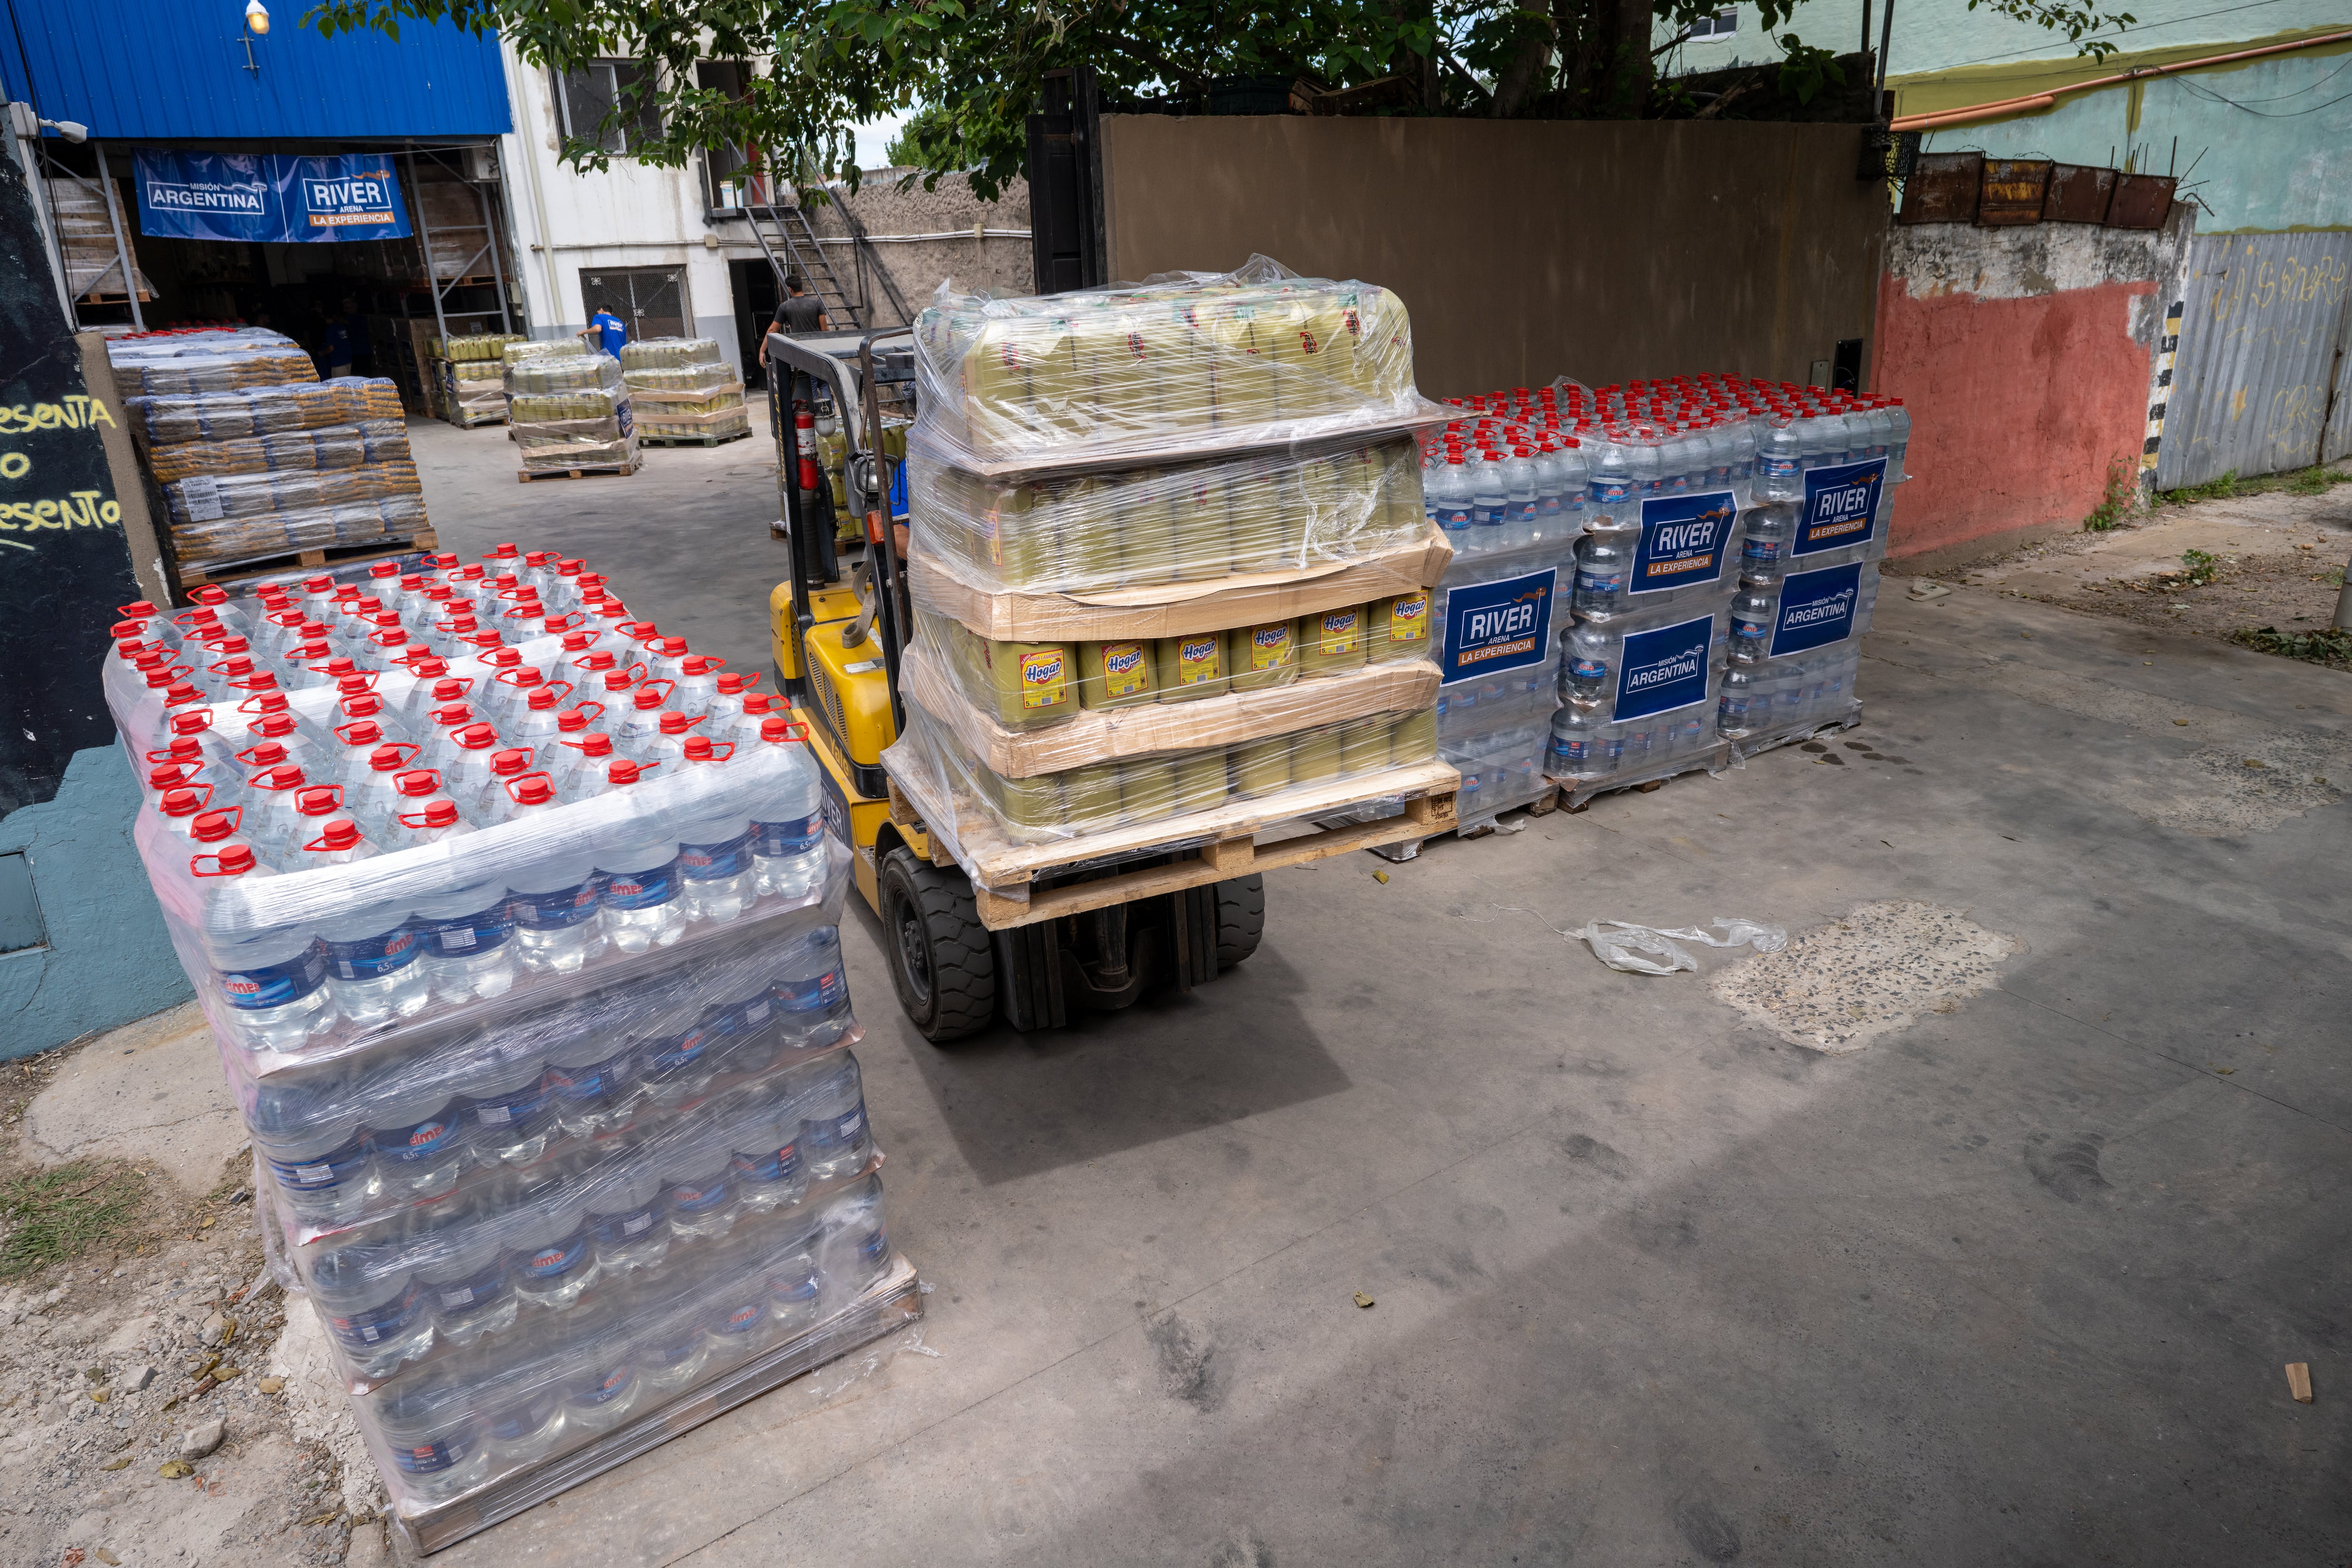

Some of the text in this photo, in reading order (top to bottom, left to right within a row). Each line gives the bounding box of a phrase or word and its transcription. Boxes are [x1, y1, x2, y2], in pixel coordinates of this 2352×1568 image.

[190, 182, 220, 191] MISIÓN
[313, 182, 382, 206] RIVER
[153, 189, 260, 208] ARGENTINA
[313, 214, 390, 225] LA EXPERIENCIA
[772, 371, 779, 392] 25
[1819, 487, 1867, 517] RIVER
[1821, 520, 1863, 536] EXPERIENCIA
[1832, 514, 1848, 523] ARENA
[1659, 522, 1714, 551] RIVER
[1676, 549, 1692, 559] ARENA
[1650, 557, 1708, 574] LA EXPERIENCIA
[1395, 601, 1424, 615] Hogar
[1812, 597, 1829, 606] MISIÓN
[1325, 613, 1355, 629] Hogar
[1470, 604, 1533, 640] RIVER
[1786, 602, 1845, 624] ARGENTINA
[1255, 627, 1286, 644] Hogar
[1488, 635, 1510, 645] ARENA
[1184, 641, 1215, 659] Hogar
[1462, 640, 1532, 664] LA EXPERIENCIA
[1109, 650, 1141, 670] Hogar
[1658, 656, 1677, 667] MISIÓN
[1026, 661, 1060, 681] Hogar
[1629, 659, 1695, 687] ARGENTINA
[829, 730, 849, 776] Yale
[822, 786, 843, 836] IVER
[409, 1123, 445, 1147] cimes
